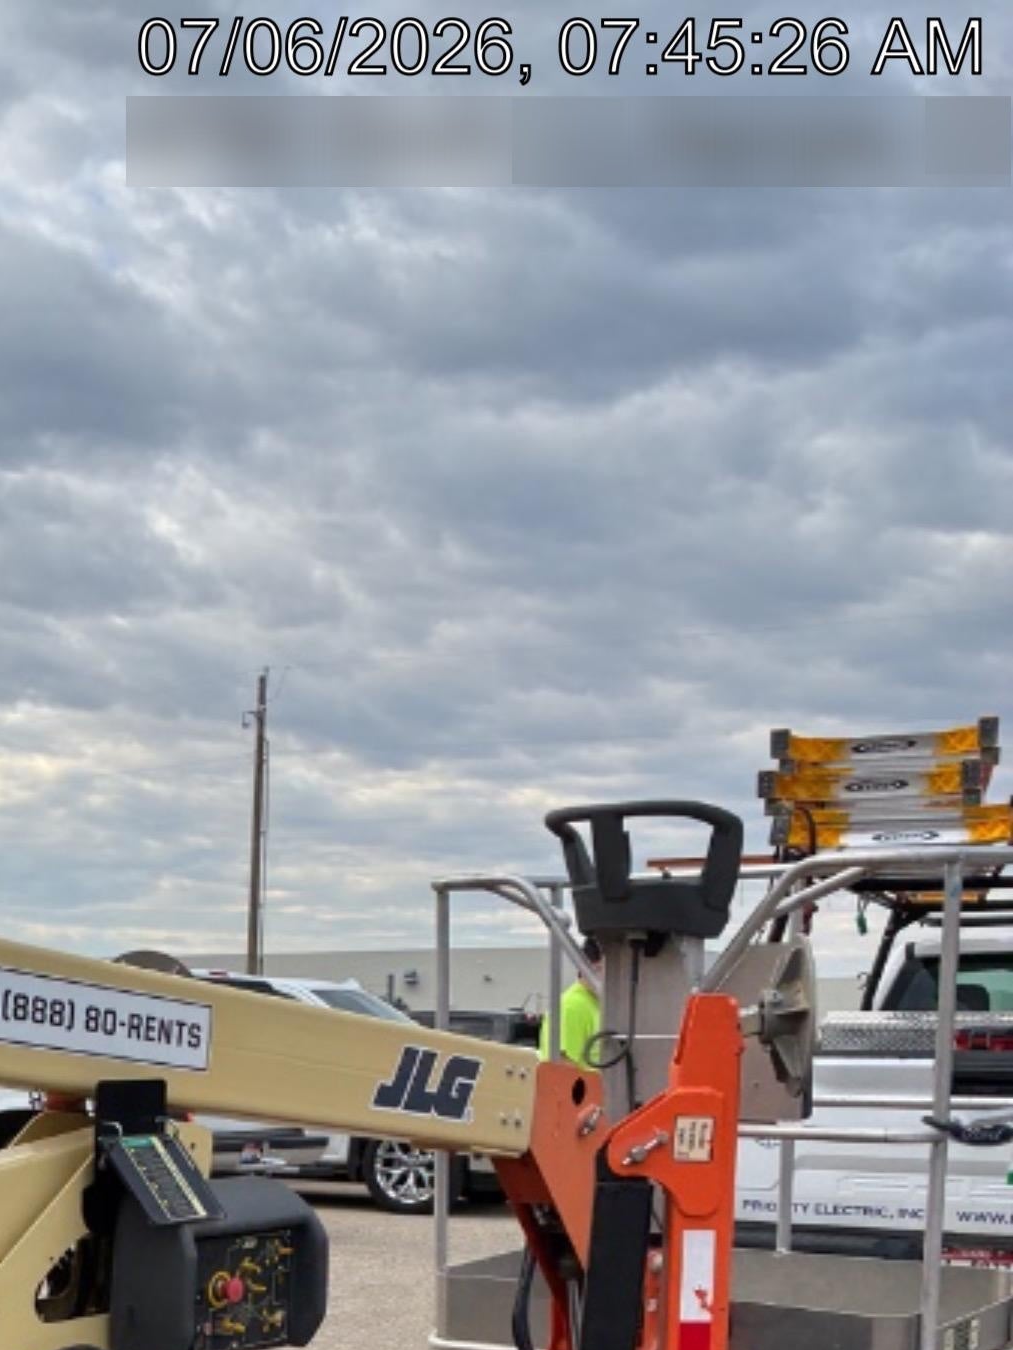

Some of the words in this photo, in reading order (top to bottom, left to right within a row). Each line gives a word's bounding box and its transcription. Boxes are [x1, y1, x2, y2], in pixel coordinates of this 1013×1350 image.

[2, 988, 75, 1031] (888)
[84, 1005, 202, 1049] 80-RENTS
[371, 1044, 484, 1121] JLG
[742, 1199, 810, 1213] PRIOTY
[956, 1210, 1013, 1225] WWW.
